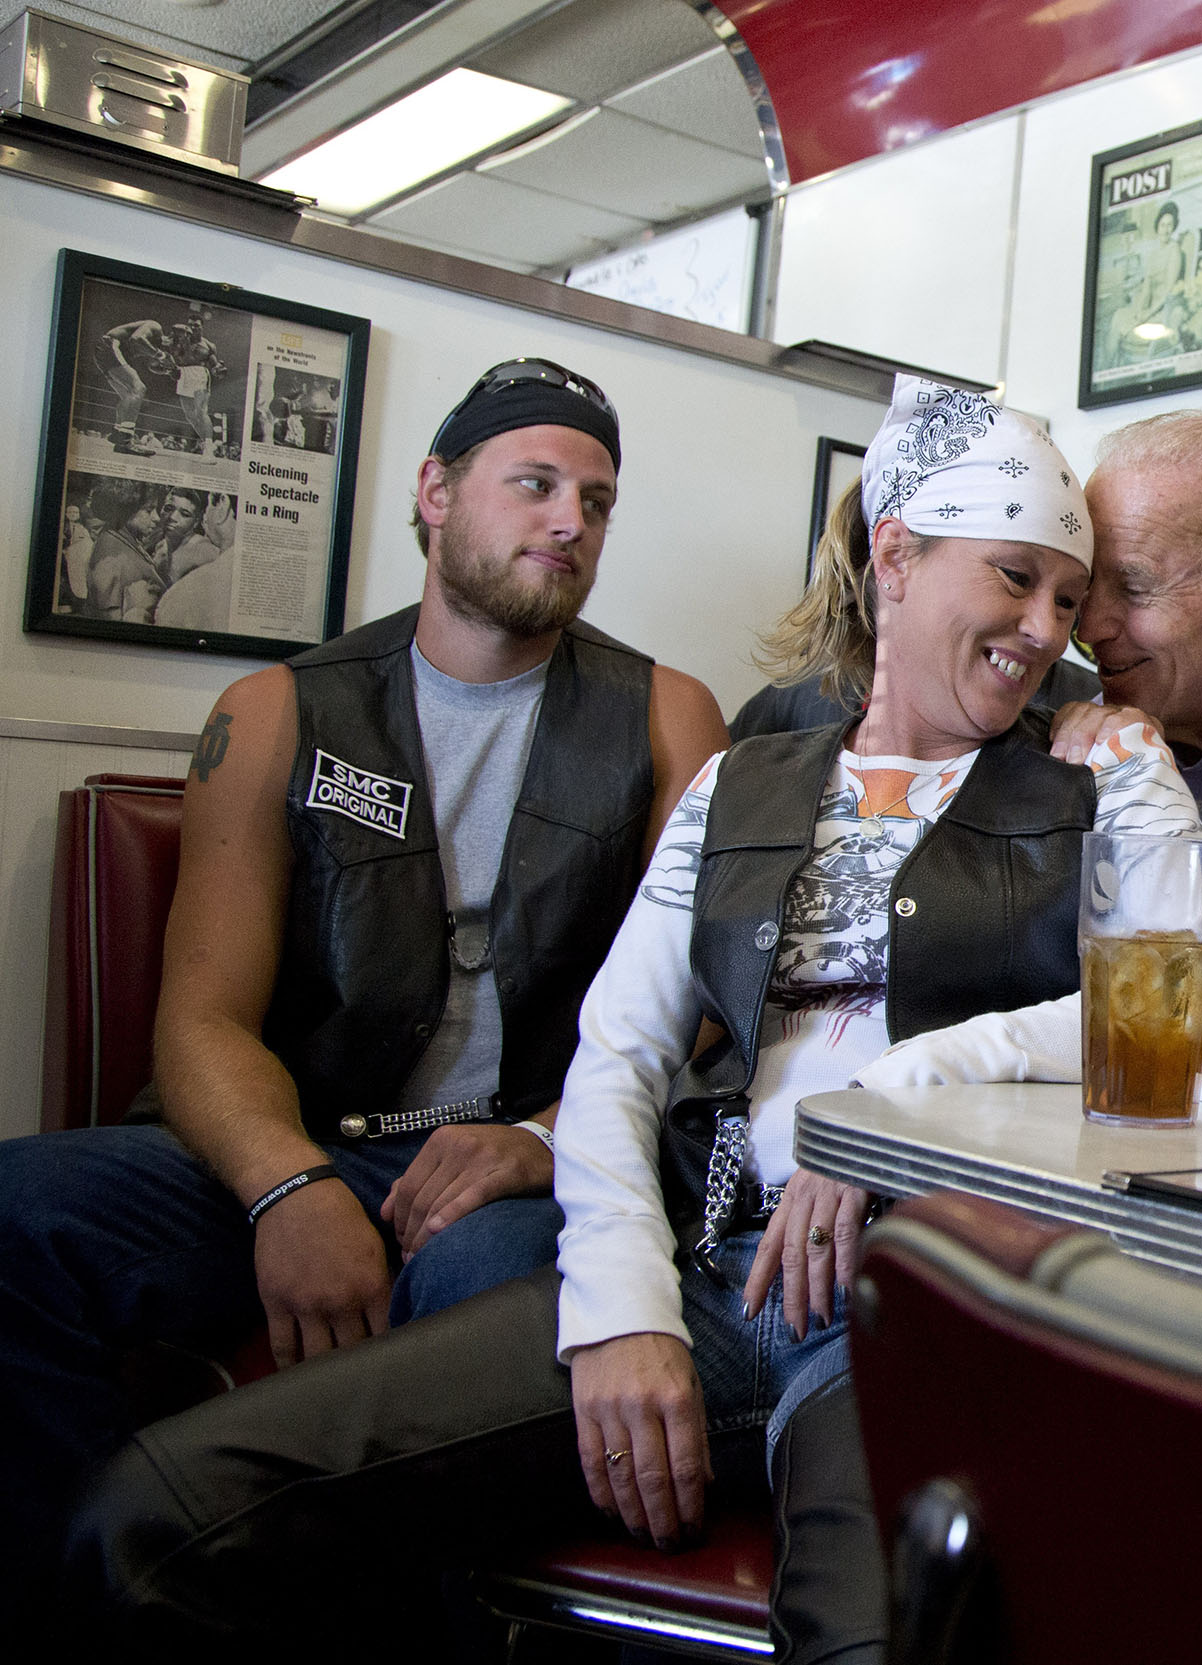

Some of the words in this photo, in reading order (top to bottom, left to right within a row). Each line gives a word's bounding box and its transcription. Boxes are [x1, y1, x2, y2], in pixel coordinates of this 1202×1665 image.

[1111, 163, 1170, 203] POST
[248, 461, 309, 485] Sickening
[260, 483, 320, 504] Spectacle
[245, 501, 257, 515] in
[261, 506, 269, 516] a
[273, 505, 300, 524] Ring
[332, 764, 392, 800] SMC
[318, 783, 399, 830] ORIGINAL
[251, 1174, 309, 1216] Shadowmen
